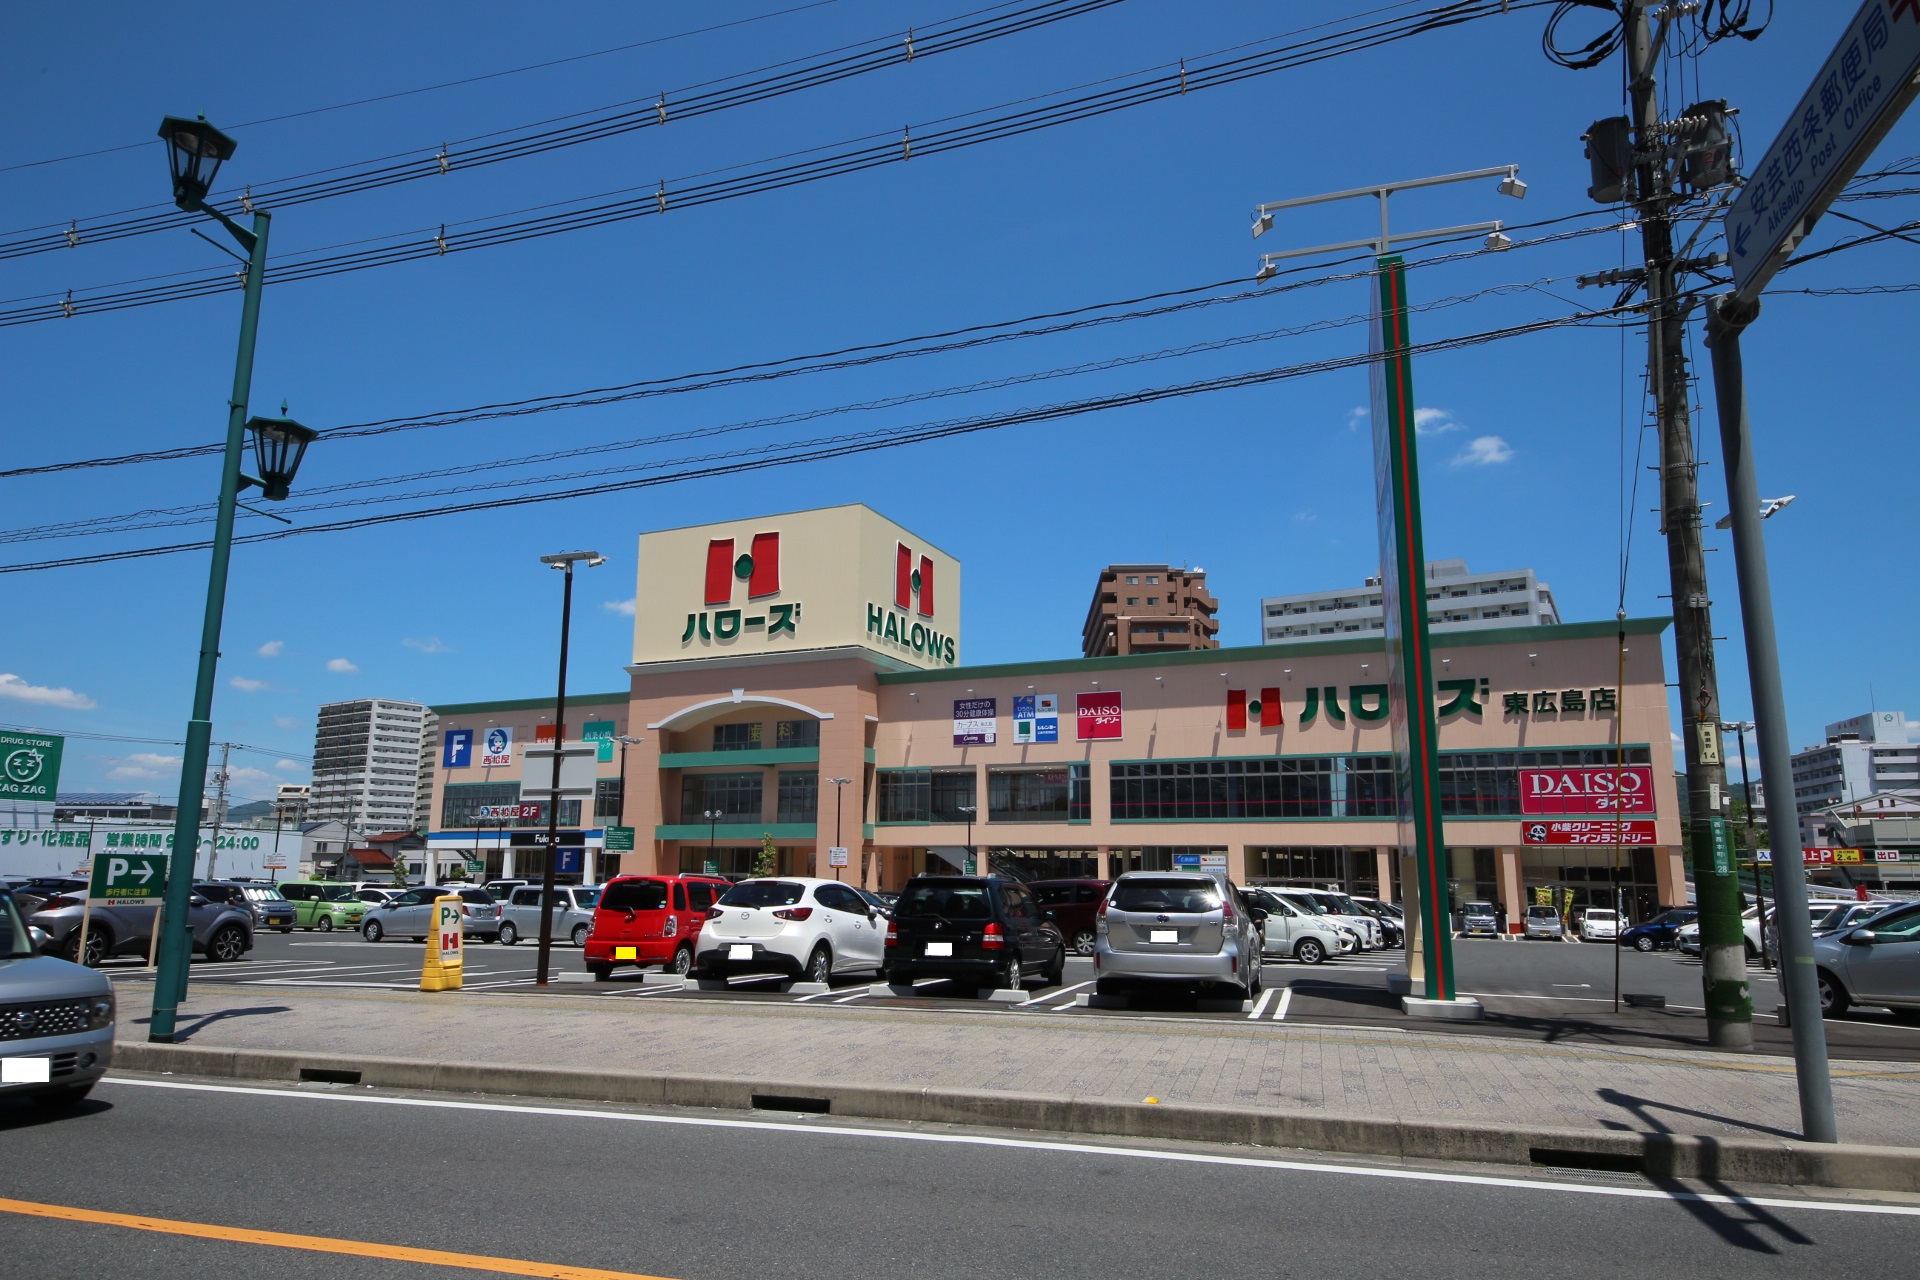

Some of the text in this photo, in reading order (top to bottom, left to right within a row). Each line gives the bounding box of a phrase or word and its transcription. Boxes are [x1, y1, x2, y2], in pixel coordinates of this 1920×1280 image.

[1750, 3, 1889, 226] 安芸西条郵便局
[1768, 75, 1882, 235] Akisaijo Post Office
[682, 602, 801, 643] ハローズ
[866, 601, 955, 664] HALOWS
[959, 701, 991, 709] 女性だけの
[1299, 677, 1616, 722] ハロズ 東広島店
[955, 708, 994, 718] 30分健康体操
[1079, 706, 1119, 716] DAISO
[1095, 717, 1120, 725] ダイソー
[1, 736, 53, 748] DRUG STORE
[483, 755, 510, 765] 西松屋
[1531, 771, 1642, 794] DAISO
[0, 784, 46, 794] AG ZAG
[1595, 797, 1644, 810] ダイソー
[491, 805, 538, 817] 西松屋 2F
[1551, 822, 1631, 832] 小柴クリーニング
[106, 832, 162, 848] 営業時間
[535, 834, 560, 843] Fuka
[1570, 833, 1652, 843] コインランドリー
[1876, 851, 1898, 860] 出口
[106, 857, 129, 886] P
[1717, 865, 1728, 873] 28
[116, 898, 145, 906] HALOWS
[441, 907, 451, 926] P
